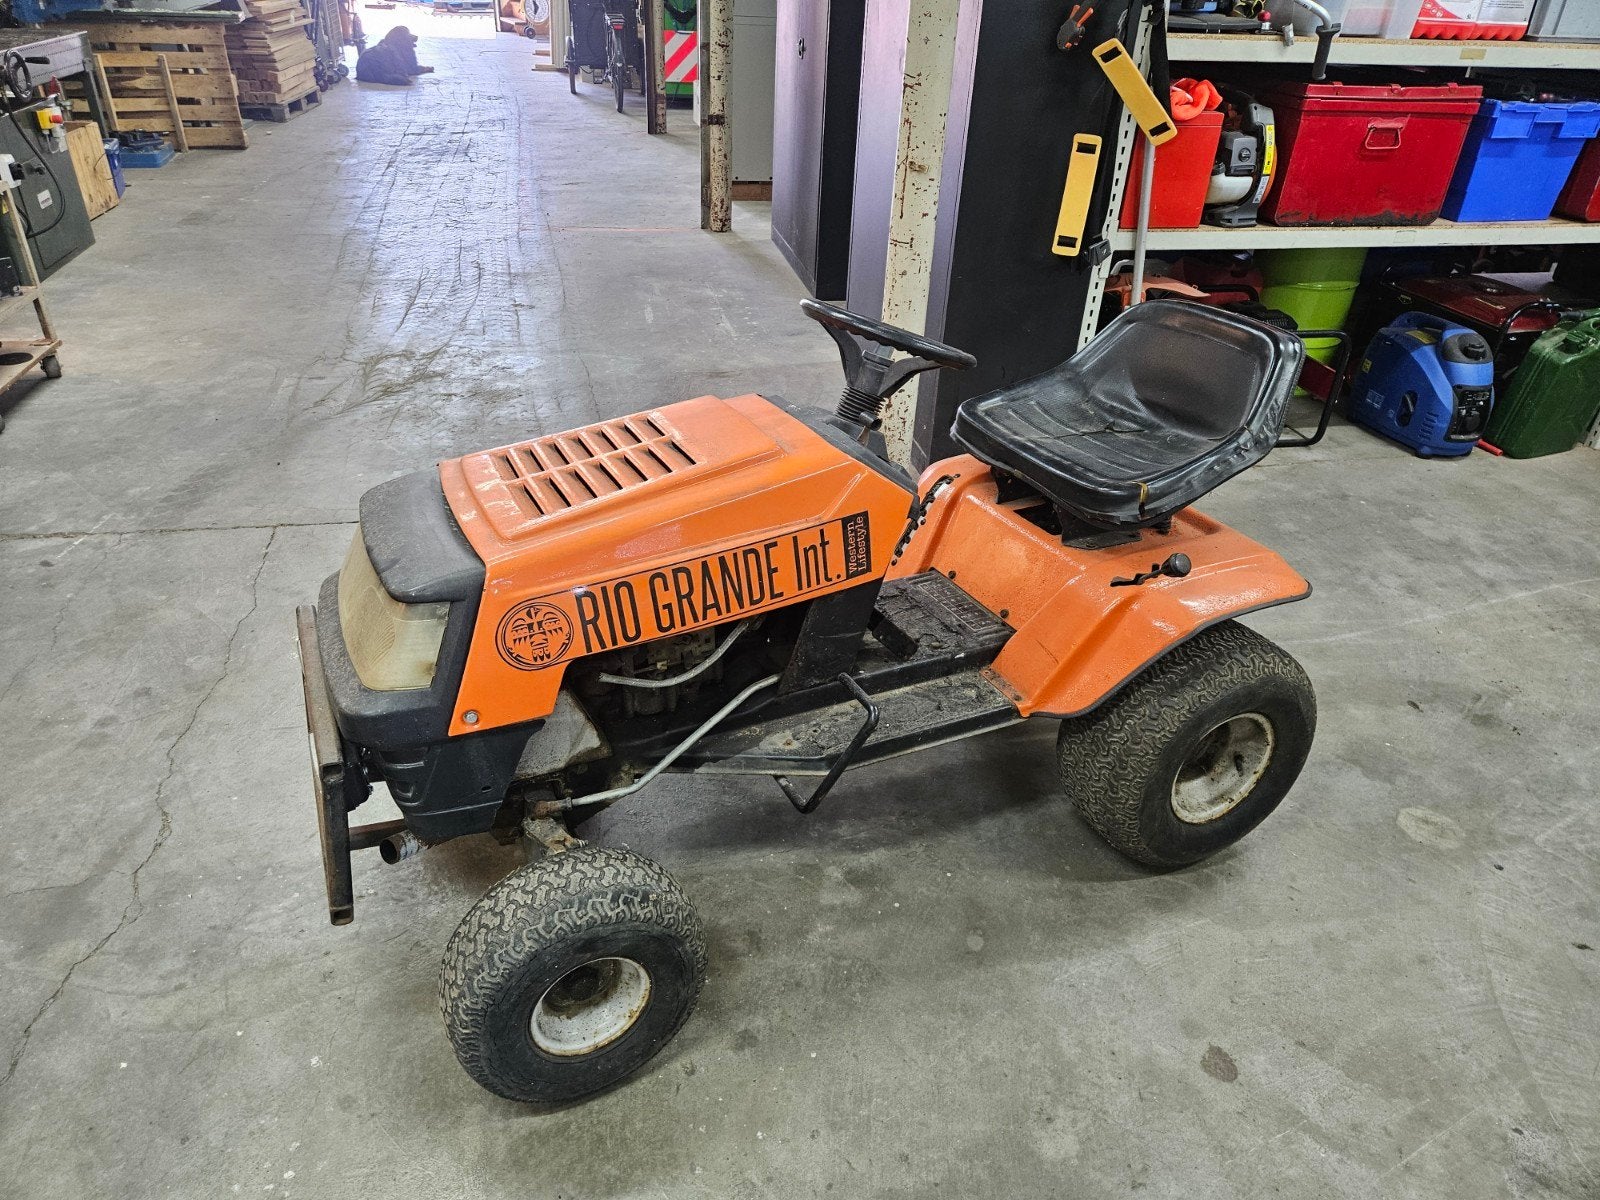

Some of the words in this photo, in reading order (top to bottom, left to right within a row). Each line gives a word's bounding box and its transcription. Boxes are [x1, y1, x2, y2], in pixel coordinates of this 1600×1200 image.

[847, 521, 857, 575] Western
[855, 516, 867, 572] Lifestyle
[574, 580, 642, 653] RIO
[649, 541, 784, 633] GRANDE
[792, 528, 842, 592] Int.
